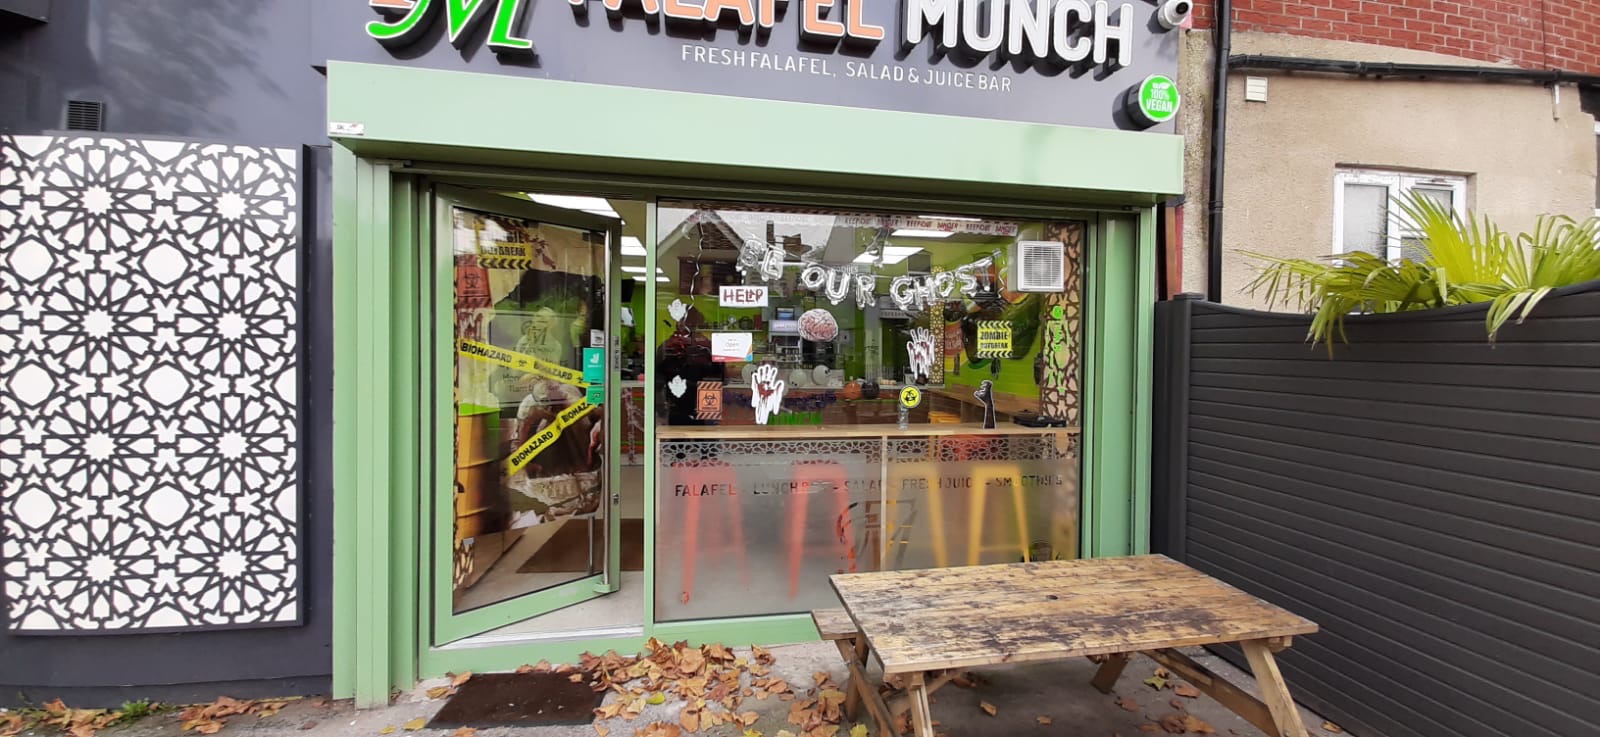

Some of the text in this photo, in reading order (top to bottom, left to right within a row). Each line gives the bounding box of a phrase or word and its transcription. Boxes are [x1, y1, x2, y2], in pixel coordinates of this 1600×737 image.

[567, 0, 1134, 67] LAFEL MUNCH
[681, 45, 1012, 93] FRESH FALAFEL, SALAD & JUICE BAR
[1151, 88, 1170, 100] 100%
[1146, 98, 1173, 112] VEGAN
[937, 221, 959, 232] DANGER
[995, 224, 1017, 235] DANGER
[802, 265, 876, 309] OUR
[890, 258, 993, 311] GHOST
[980, 331, 1008, 340] ZOMBIE
[461, 342, 512, 364] BIOHAZARD
[533, 360, 574, 381] BAZARD
[511, 430, 554, 467] BIOHAZARD
[675, 484, 737, 497] FALAFEL
[902, 478, 943, 490] FRE
[944, 476, 974, 489] JUIC
